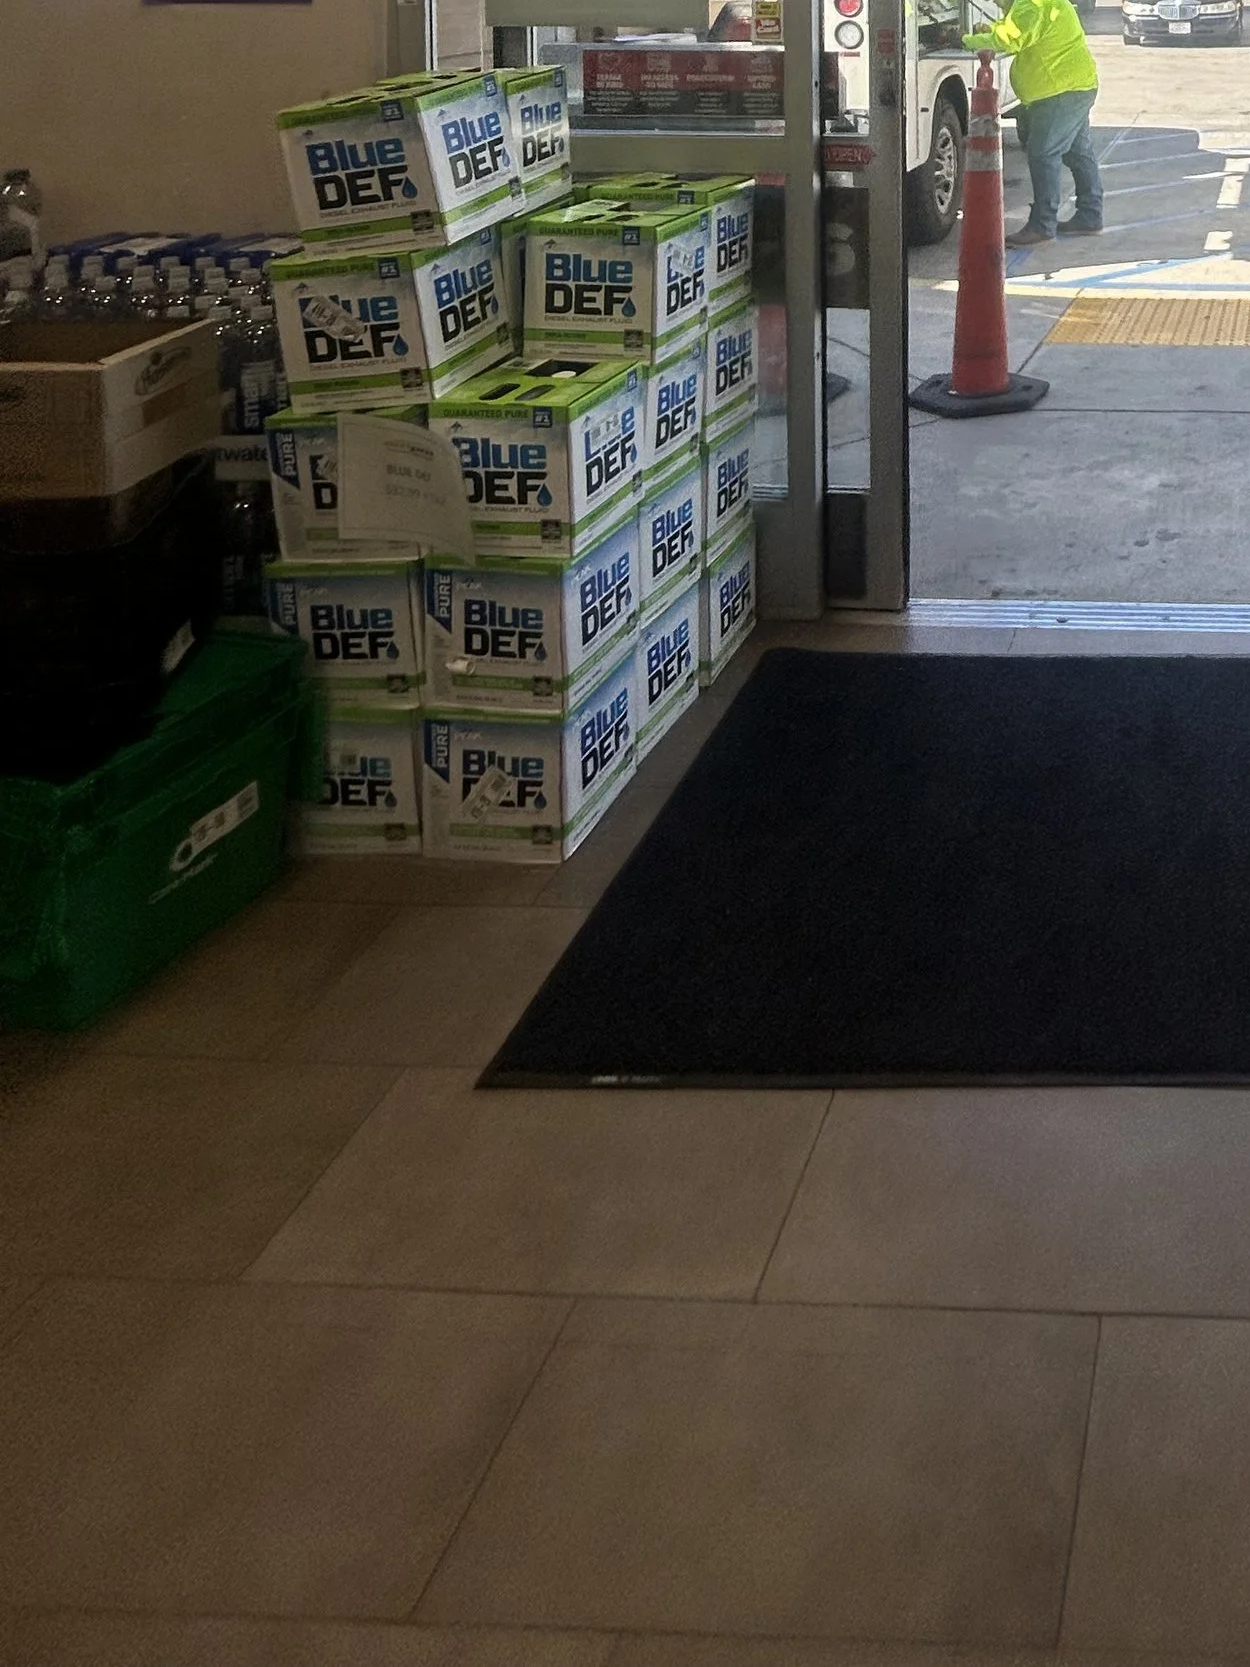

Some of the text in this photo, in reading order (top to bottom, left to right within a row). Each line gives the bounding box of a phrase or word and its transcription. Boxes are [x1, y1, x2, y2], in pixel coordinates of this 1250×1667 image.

[441, 111, 502, 155] Blue
[520, 100, 562, 130] Blue
[306, 138, 405, 176] Blue
[448, 135, 505, 189] DEF
[521, 132, 561, 168] DEF
[312, 164, 408, 210] DEF
[716, 212, 749, 244] Blue
[545, 253, 634, 284] Blue
[716, 233, 749, 274] DEF
[434, 259, 494, 310] Blue
[545, 283, 633, 316] DEF
[666, 269, 705, 317] DEF
[439, 282, 495, 344] DEF
[716, 328, 752, 366] Blue
[657, 373, 697, 415] Blue
[715, 356, 753, 397] DEF
[443, 409, 528, 419] GUARANTEED PURE
[655, 396, 696, 449] DEF
[283, 433, 297, 477] PURE
[452, 437, 547, 470] Blue
[586, 429, 635, 498] DEF
[717, 447, 750, 485] Blue
[716, 468, 750, 519] DEF
[652, 498, 693, 547] Blue
[652, 521, 693, 578] DEF
[438, 573, 450, 618] PURE
[580, 551, 630, 613] Blue
[719, 561, 750, 611] Blue
[310, 604, 393, 631] Blue
[464, 599, 544, 630] Blue
[581, 575, 630, 647] DEF
[720, 582, 750, 637] DEF
[312, 631, 395, 660] DEF
[464, 627, 545, 659] DEF
[646, 617, 689, 676] Blue
[648, 639, 690, 707] DEF
[580, 688, 628, 758] Blue
[437, 724, 448, 769] PURE
[462, 749, 544, 778] Blue
[581, 710, 629, 791] DEF
